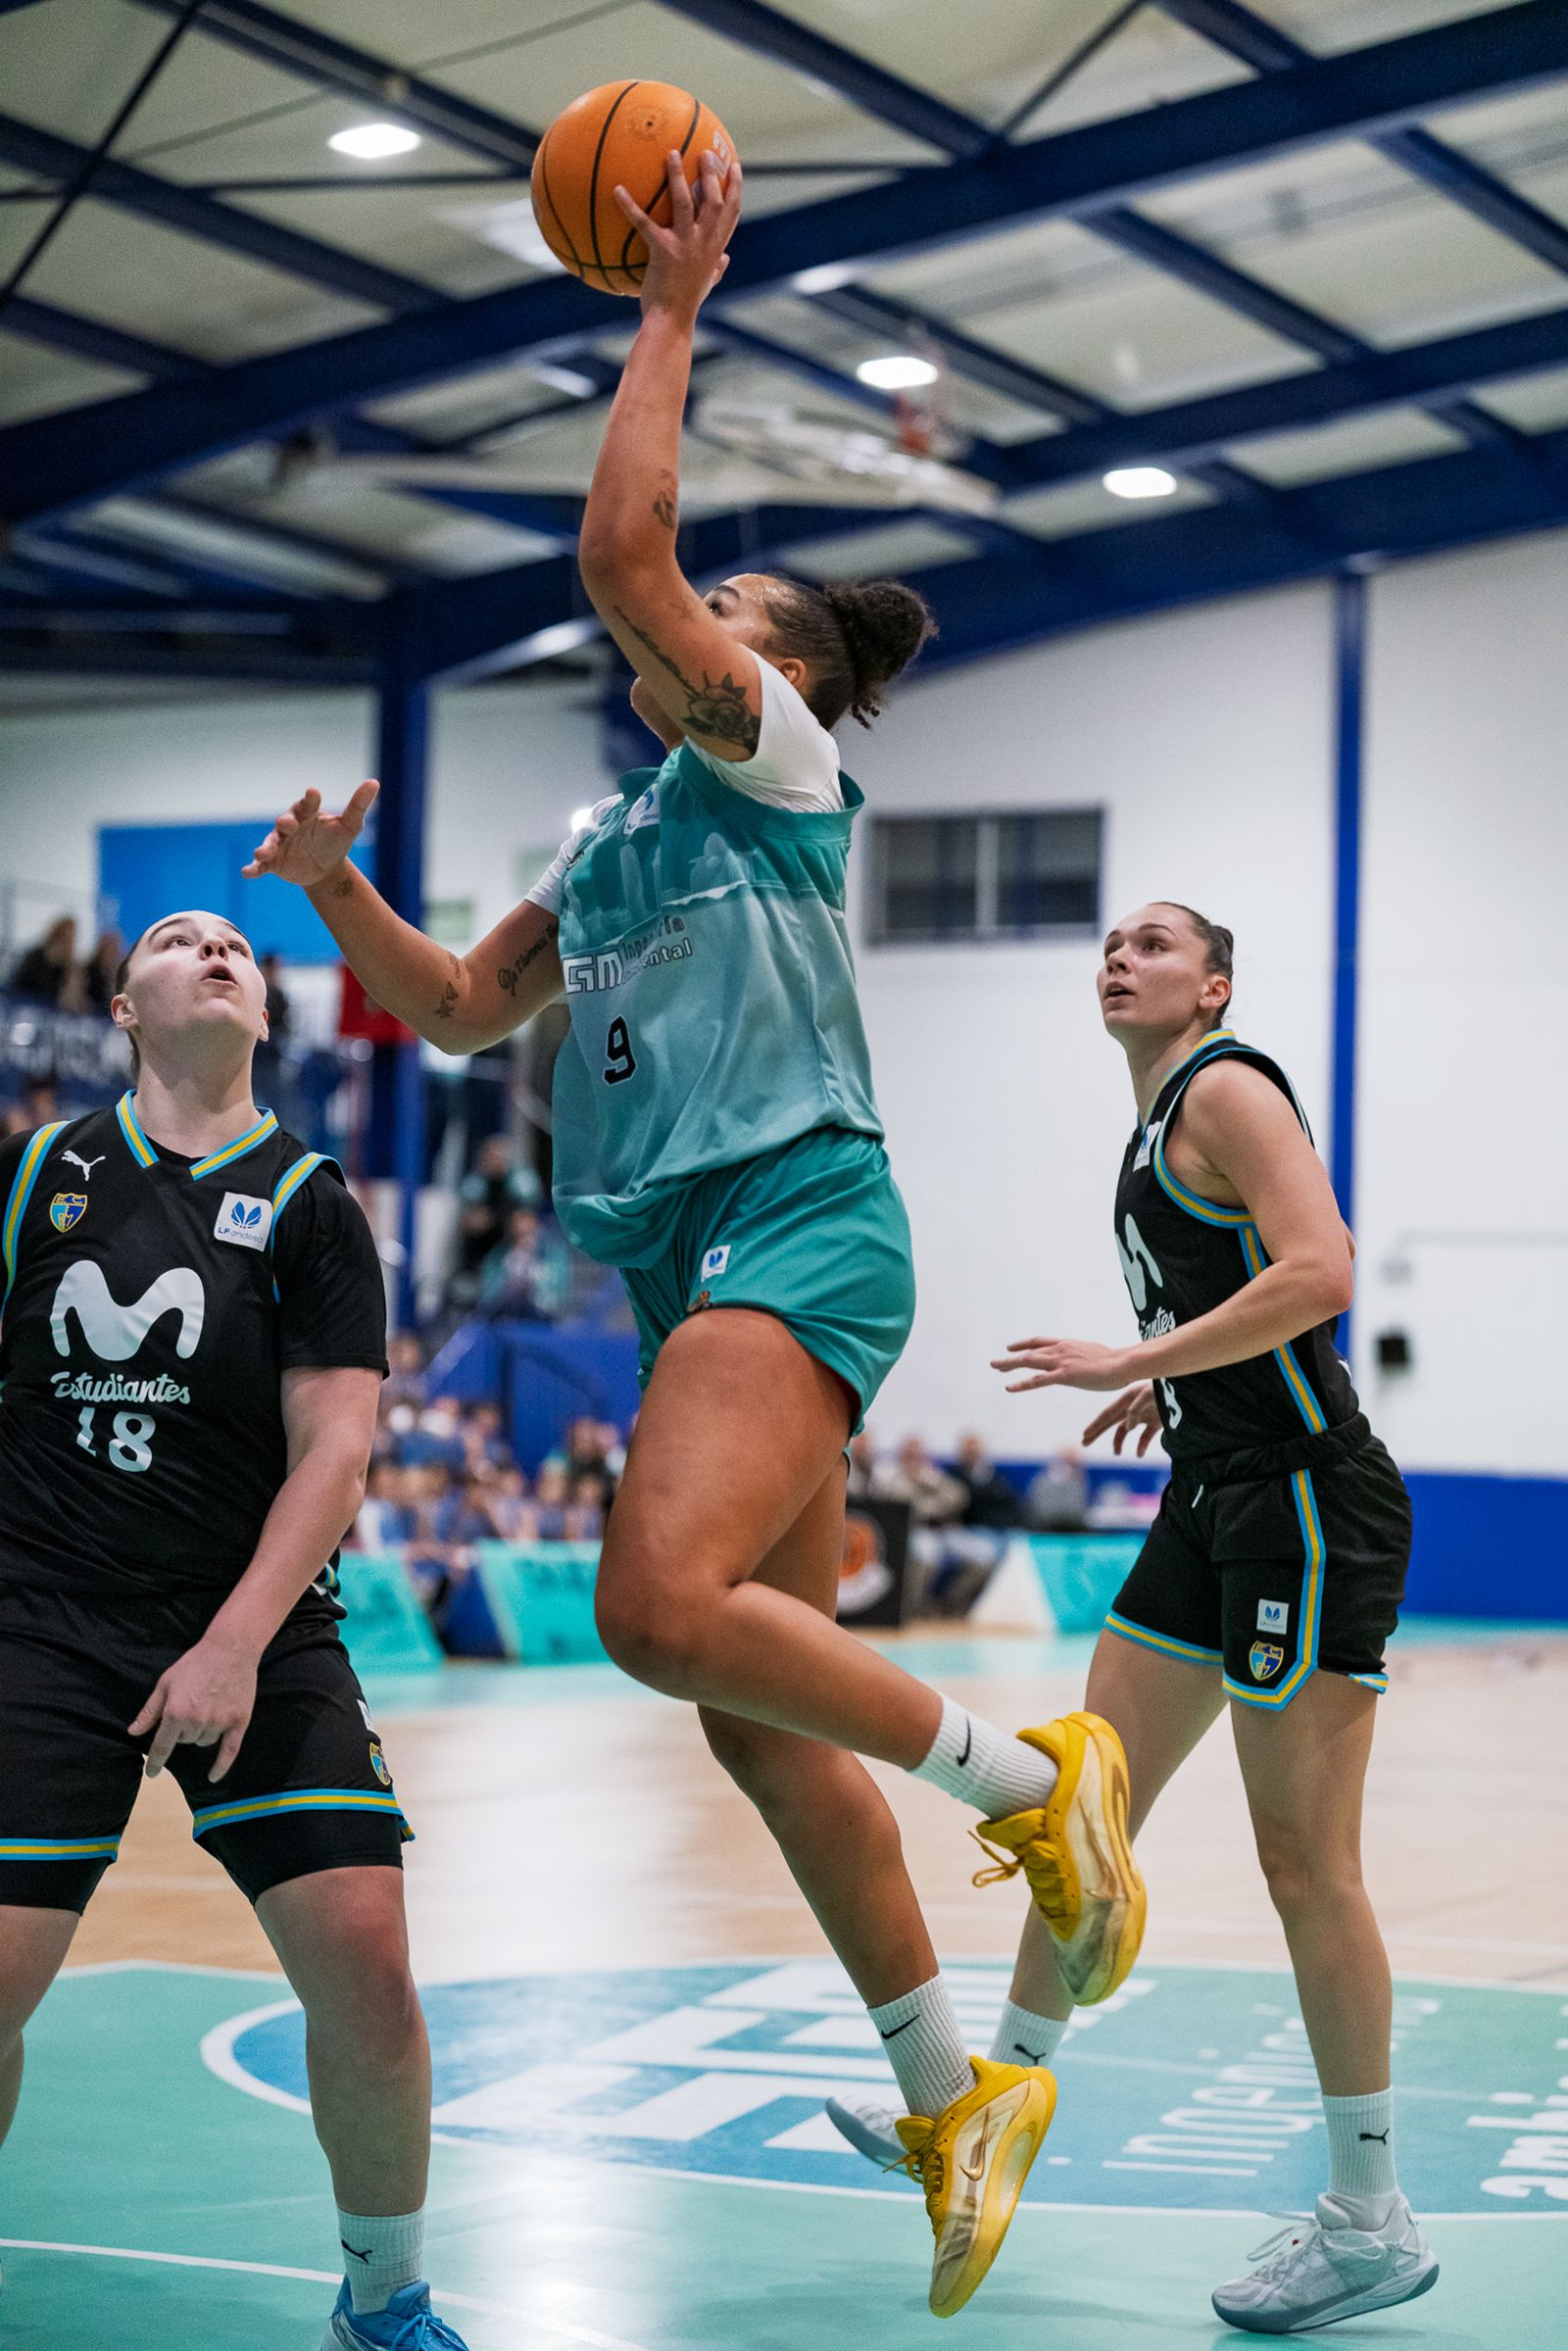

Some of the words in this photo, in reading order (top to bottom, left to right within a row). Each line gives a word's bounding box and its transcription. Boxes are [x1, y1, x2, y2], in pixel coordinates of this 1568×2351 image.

[604, 1014, 637, 1085] 9
[50, 1371, 191, 1404] Estudiantes
[75, 1406, 157, 1473] 18
